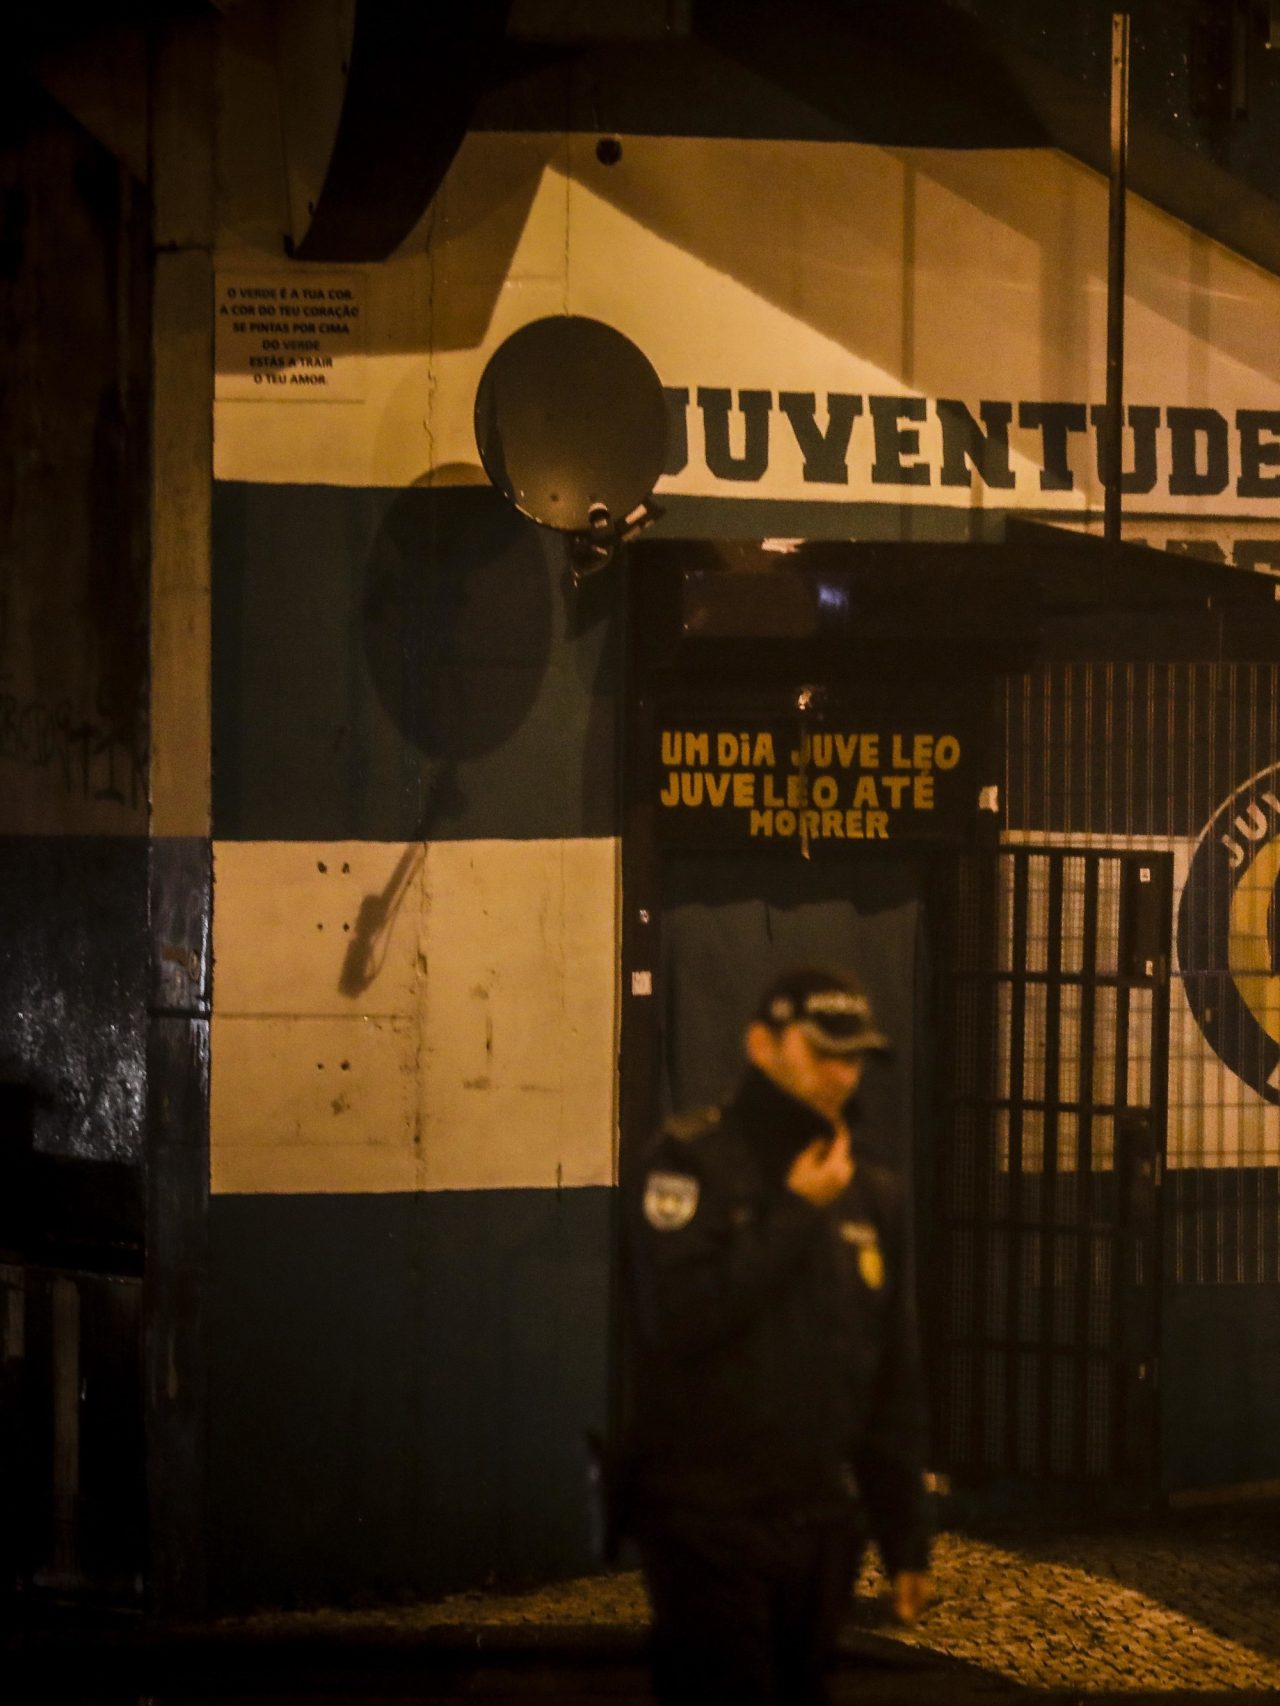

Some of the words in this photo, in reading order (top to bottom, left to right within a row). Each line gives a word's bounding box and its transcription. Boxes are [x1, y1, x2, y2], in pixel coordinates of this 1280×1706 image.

[227, 288, 237, 299] O
[240, 288, 276, 299] VERDE
[291, 288, 299, 299] A
[303, 289, 325, 299] TUA
[220, 306, 229, 316] A
[232, 306, 255, 316] COR
[258, 306, 276, 316] DO
[279, 306, 300, 317] TEU
[303, 305, 359, 318] CORAÇÃO
[233, 322, 246, 333] SE
[250, 322, 290, 333] PINTAS
[293, 323, 316, 333] POR
[319, 323, 349, 333] CIMA
[262, 340, 280, 350] DO
[283, 340, 320, 350] VERDE
[288, 357, 297, 368] A
[300, 357, 333, 368] TRAIR
[254, 374, 262, 385] O
[266, 374, 287, 384] TEU
[661, 731, 709, 766] UM
[791, 733, 879, 768] JUVE
[892, 734, 960, 770] LEO
[661, 772, 755, 807] JUVE
[763, 775, 838, 809] LEO
[750, 809, 888, 839] MORRER
